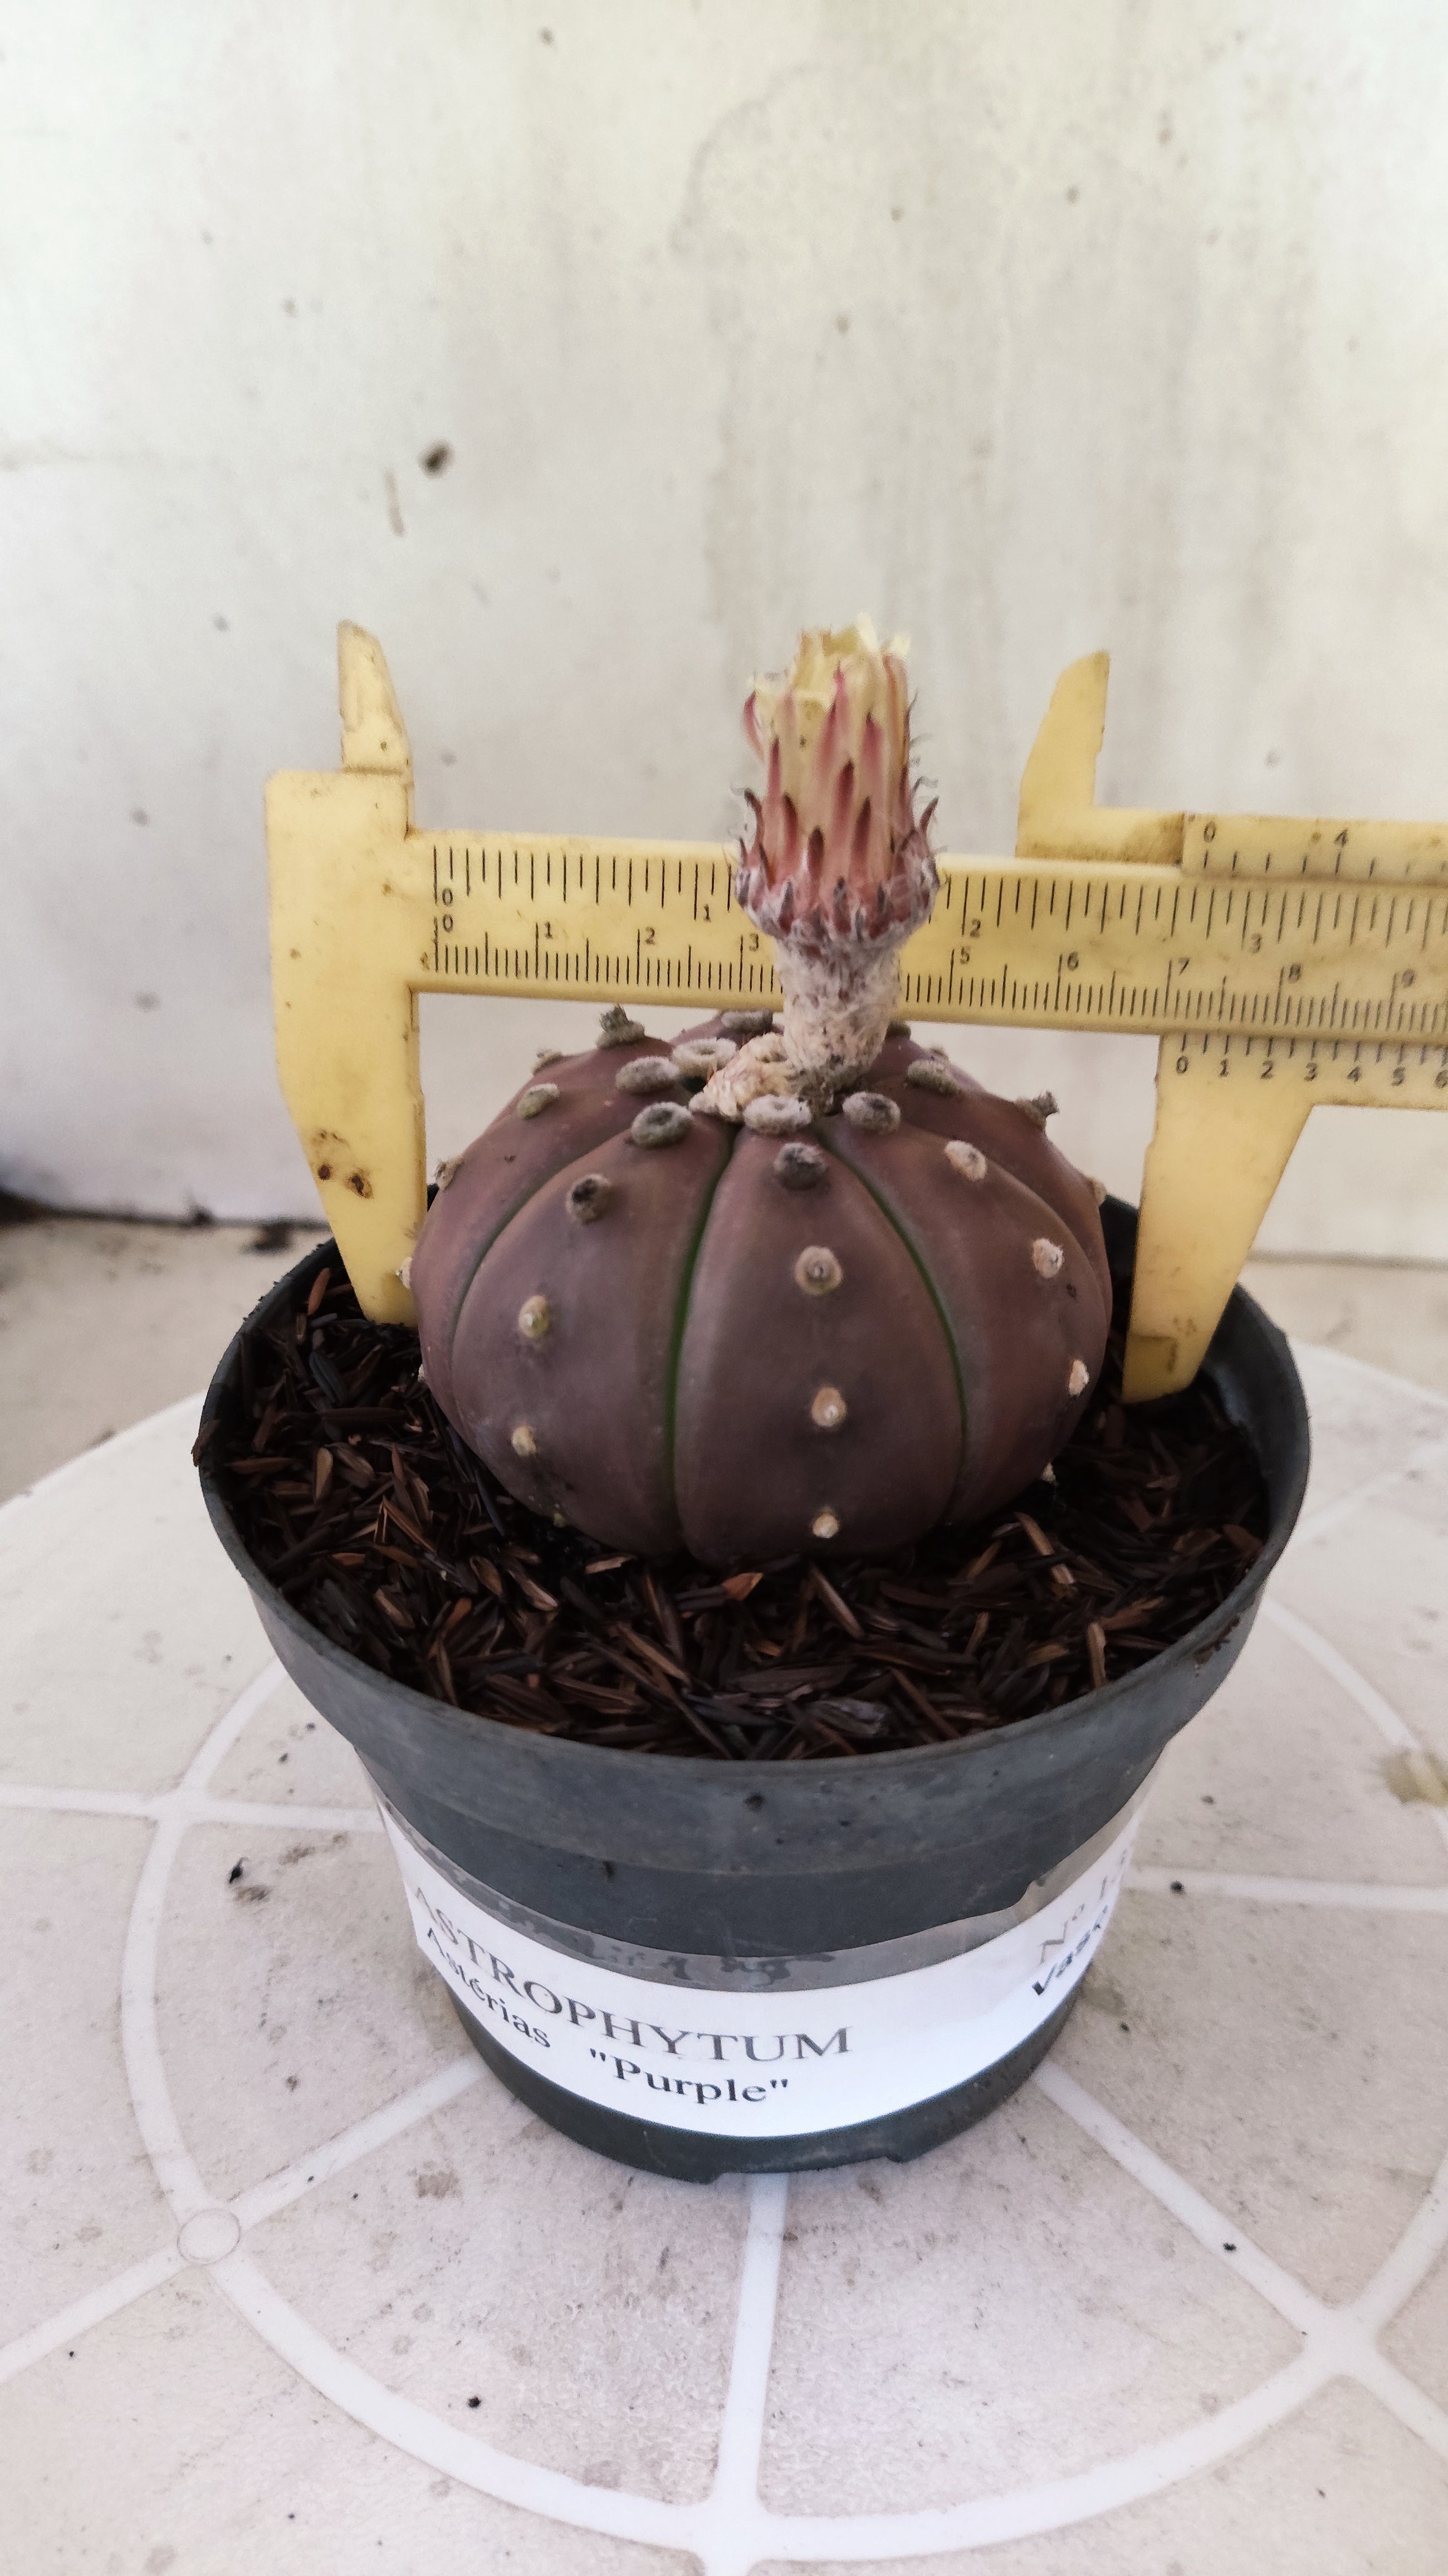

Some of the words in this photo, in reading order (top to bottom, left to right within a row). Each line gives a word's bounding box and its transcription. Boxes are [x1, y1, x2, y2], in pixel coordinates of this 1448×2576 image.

[1204, 821, 1216, 843] 0
[441, 886, 453, 906] 0
[703, 904, 711, 922] 1
[970, 918, 981, 938] 2
[1251, 932, 1263, 953] 3
[441, 914, 453, 933] 0
[544, 921, 554, 939] 1
[645, 926, 657, 944] 2
[749, 934, 759, 951] 3
[960, 947, 970, 964] 5
[1067, 951, 1079, 971] 6
[1178, 957, 1191, 975] 7
[1288, 962, 1302, 983] 8
[1176, 1055, 1188, 1075] 0
[1219, 1058, 1229, 1078] 1
[1260, 1060, 1274, 1080] 2
[1304, 1062, 1318, 1082] 3
[1347, 1066, 1363, 1083] 4
[1391, 1066, 1407, 1087] 5
[414, 1886, 853, 2063] ASTROPHYTUM
